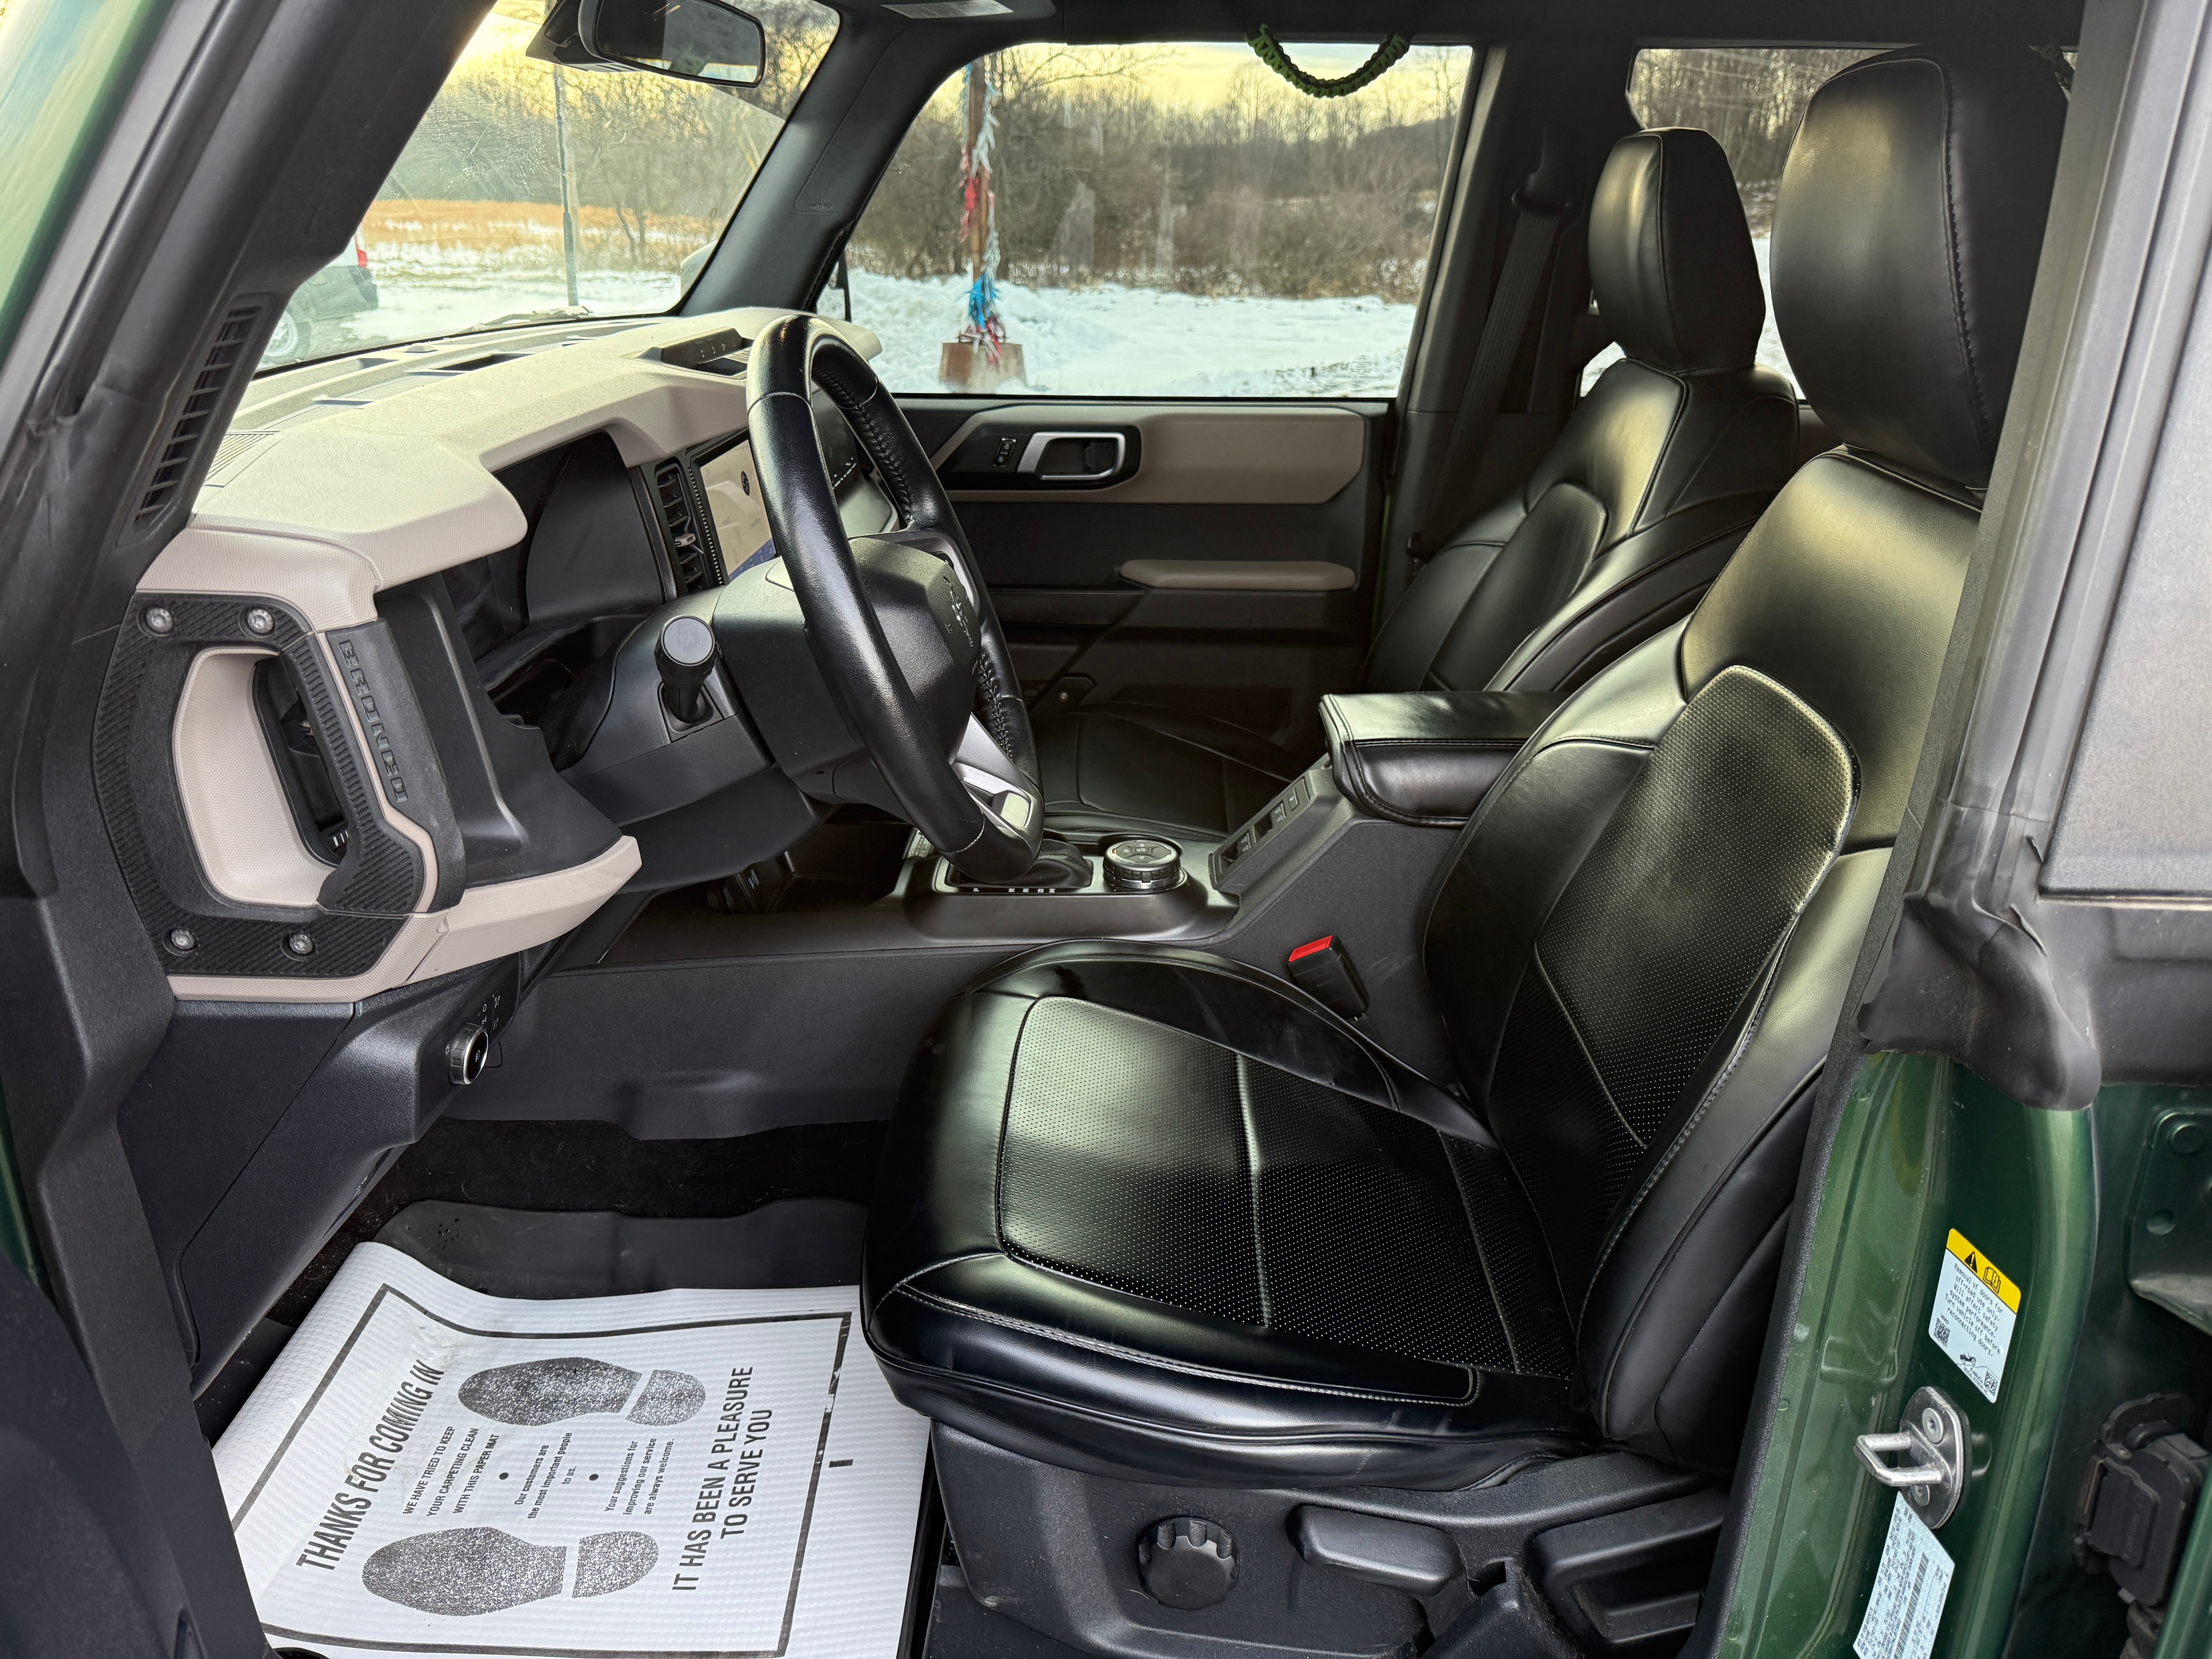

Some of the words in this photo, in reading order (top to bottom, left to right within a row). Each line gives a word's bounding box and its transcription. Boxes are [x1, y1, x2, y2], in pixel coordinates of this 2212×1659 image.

[339, 640, 409, 802] BRONCO
[1954, 1263, 1971, 1284] Removal
[1980, 1289, 1993, 1305] doors
[1995, 1303, 2003, 1314] for
[1954, 1283, 1964, 1297] Will
[1965, 1296, 1981, 1314] affect
[1983, 1312, 1999, 1333] safety
[1956, 1276, 1975, 1298] off-road
[1977, 1298, 1985, 1308] use
[1987, 1307, 2000, 1322] only.
[1940, 1314, 1949, 1324] VIDEO
[1945, 1293, 1955, 1308] Turn
[1956, 1306, 1974, 1327] vehicle
[1975, 1325, 1983, 1336] off
[1984, 1335, 2001, 1354] before
[1947, 1307, 1977, 1341] reconnecting
[1978, 1338, 1994, 1357] doors.
[1949, 1290, 1965, 1308] system
[1965, 1306, 1996, 1338] performance.
[409, 1359, 444, 1386] IN
[369, 1381, 433, 1453] COMING
[711, 1367, 753, 1454] PLEASURE
[744, 1409, 773, 1446] YOU
[344, 1452, 395, 1492] FOR
[402, 1501, 417, 1514] WE
[410, 1480, 428, 1500] HAVE
[421, 1458, 440, 1479] TRIED
[433, 1446, 446, 1456] TO
[440, 1426, 455, 1444] KEEP
[426, 1496, 446, 1516] YOUR
[439, 1453, 467, 1494] CARPETING
[460, 1428, 479, 1451] CLEAN
[453, 1494, 471, 1513] WITH
[463, 1475, 479, 1492] THIS
[473, 1450, 492, 1473] PAPER
[485, 1434, 500, 1449] MAT
[566, 1466, 577, 1476] us.
[638, 1465, 648, 1477] our
[642, 1438, 657, 1464] service
[658, 1438, 675, 1474] welcome.
[707, 1458, 730, 1470] A
[514, 1493, 527, 1505] Our
[522, 1457, 543, 1491] customers
[538, 1445, 549, 1456] are
[527, 1507, 539, 1519] the
[534, 1489, 548, 1506] most
[541, 1456, 563, 1487] important
[558, 1432, 572, 1455] people
[604, 1495, 618, 1512] Your
[613, 1452, 634, 1494] suggestions
[627, 1441, 638, 1451] for
[622, 1479, 645, 1515] improving
[648, 1475, 663, 1501] always
[728, 1449, 763, 1507] SERVE
[644, 1502, 654, 1515] are
[692, 1476, 726, 1523] BEEN
[296, 1492, 371, 1570] THANKS
[679, 1530, 712, 1567] HAS
[720, 1513, 748, 1539] TO
[672, 1573, 699, 1590] IT
